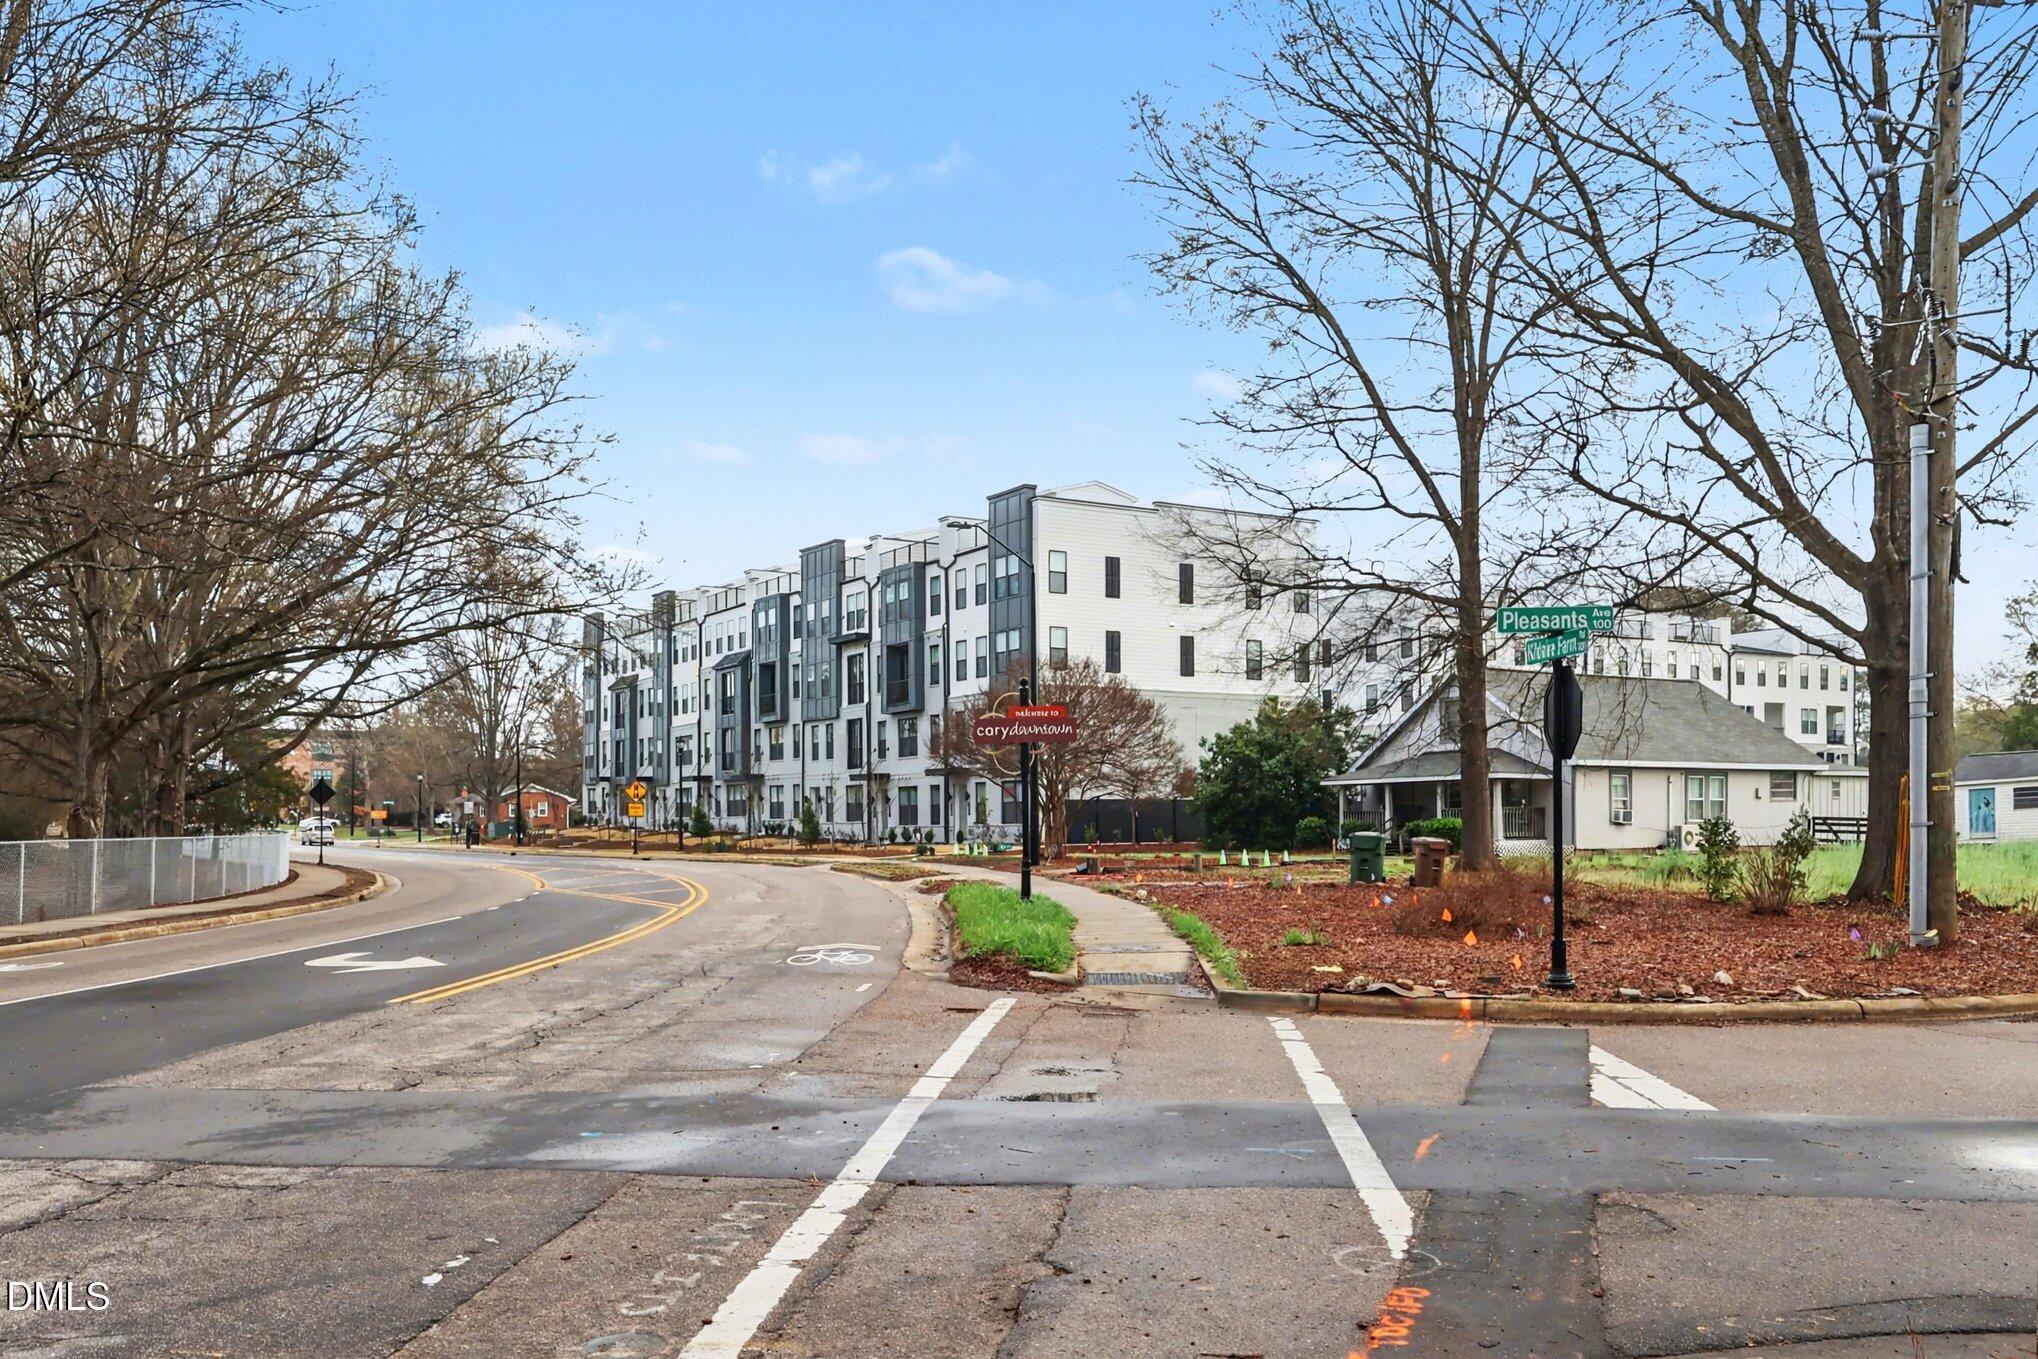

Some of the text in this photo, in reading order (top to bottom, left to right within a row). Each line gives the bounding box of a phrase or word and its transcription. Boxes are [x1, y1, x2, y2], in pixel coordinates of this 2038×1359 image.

[1503, 608, 1611, 630] Pleasants Ave
[1593, 619, 1611, 629] 100
[1557, 636, 1577, 656] Farm
